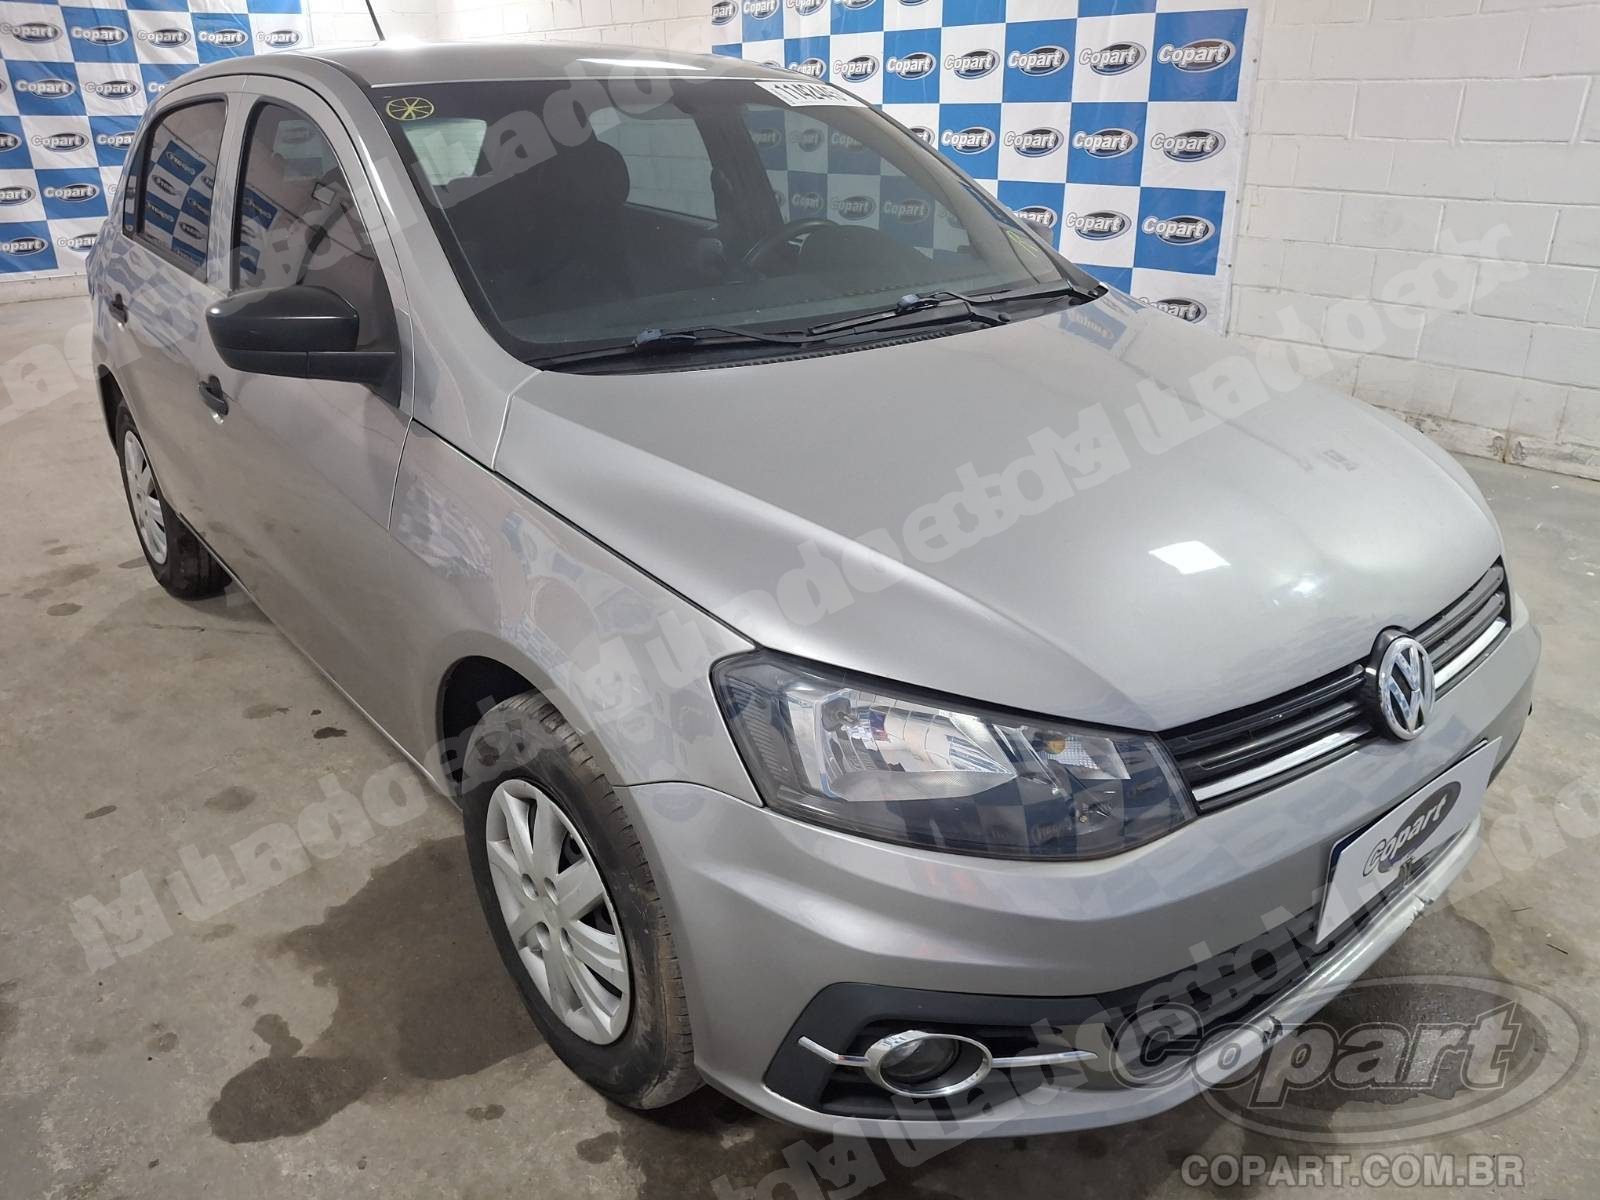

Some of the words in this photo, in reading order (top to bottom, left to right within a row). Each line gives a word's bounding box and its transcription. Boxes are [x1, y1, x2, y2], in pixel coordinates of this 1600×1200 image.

[712, 5, 733, 17] part
[743, 0, 775, 16] Copart
[0, 23, 55, 38] Copart
[71, 26, 121, 41] Copart
[137, 30, 183, 45] Copart
[198, 32, 242, 44] Copart
[257, 32, 296, 45] Copart
[886, 55, 930, 74] Copart
[944, 53, 993, 73] Copart
[1007, 49, 1062, 72] Copart
[1079, 46, 1137, 71] Copart
[1157, 43, 1227, 68] Copart
[833, 58, 873, 77] Copart
[16, 80, 69, 96] Copart
[85, 81, 134, 96] Copart
[31, 134, 80, 150] Copart
[97, 134, 132, 147] Copa
[941, 129, 988, 152] Copart
[1004, 130, 1057, 153] Copart
[1073, 131, 1132, 155] Copart
[1151, 132, 1215, 157] Copart
[44, 186, 93, 200] Copart
[883, 200, 925, 218] Copart
[1065, 211, 1123, 233] Copart
[1142, 216, 1205, 241] Copart
[2, 240, 41, 254] opart
[1363, 792, 1449, 877] Copart
